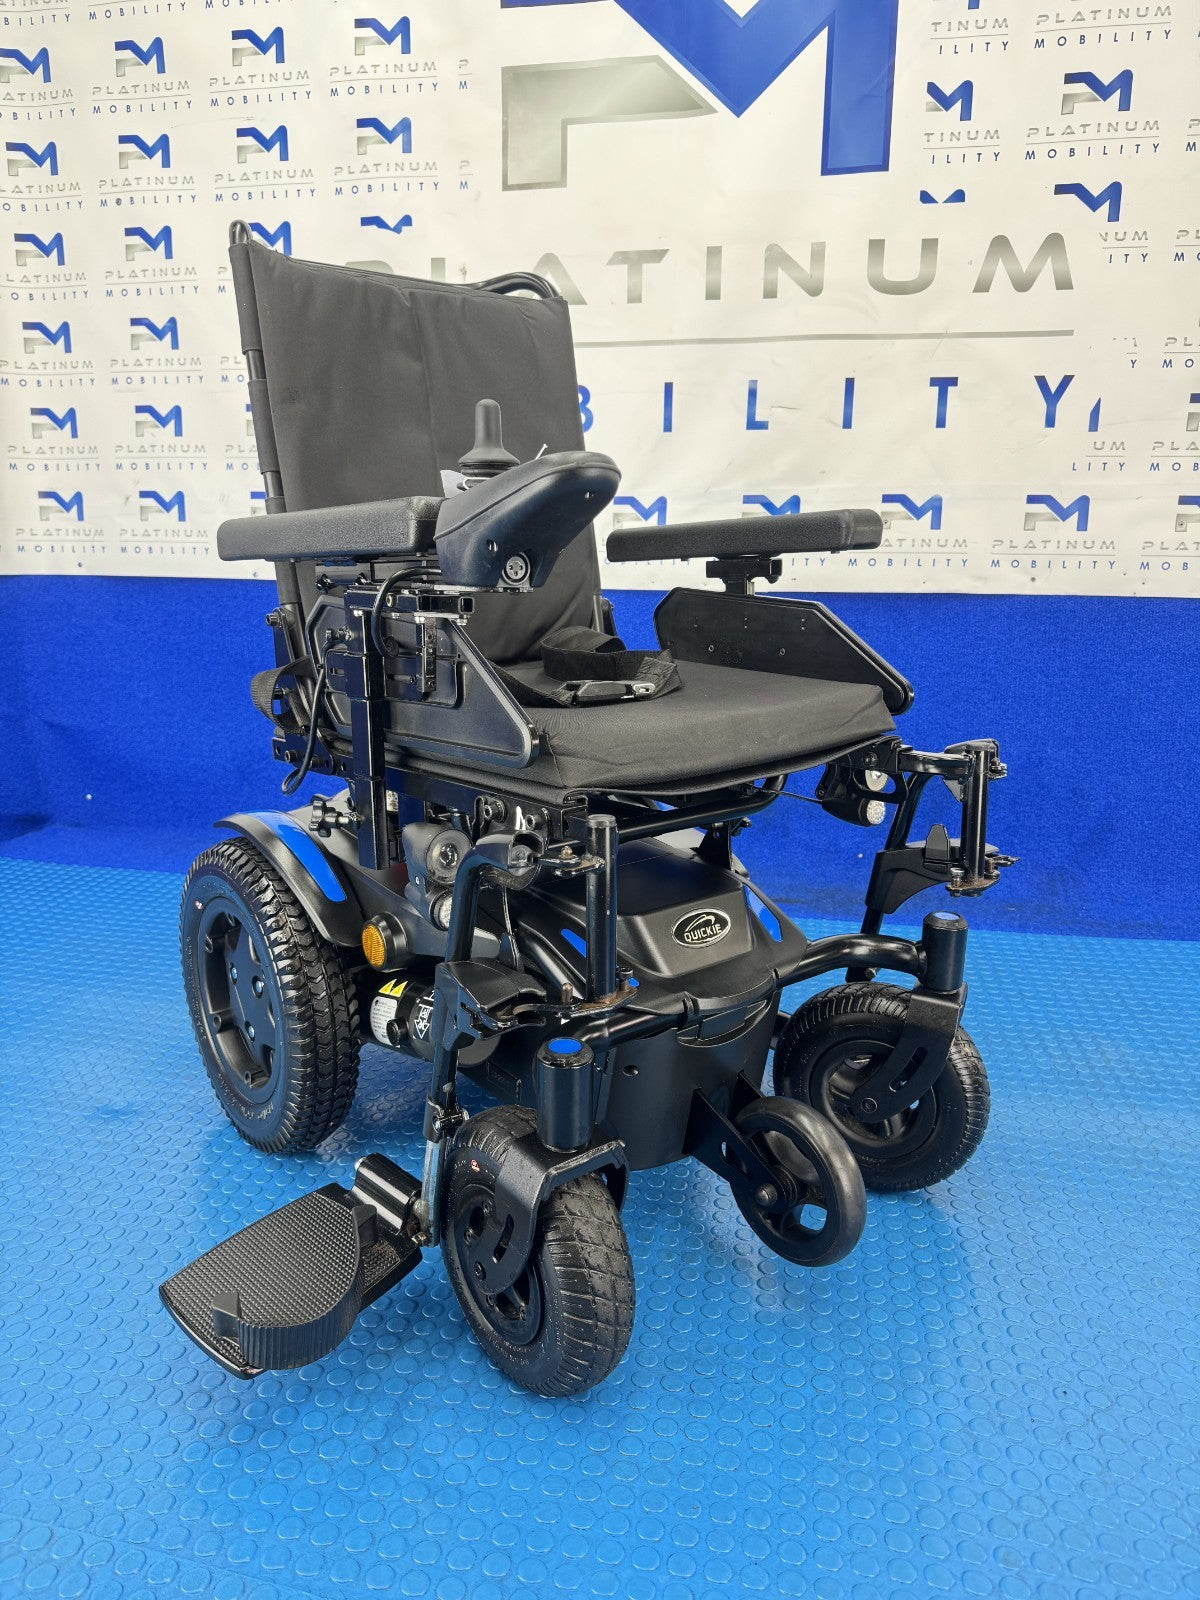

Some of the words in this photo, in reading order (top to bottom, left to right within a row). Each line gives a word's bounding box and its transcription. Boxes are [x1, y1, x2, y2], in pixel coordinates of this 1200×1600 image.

[89, 2, 185, 20] MOBILITY
[1036, 5, 1171, 25] PLATINUM
[1034, 29, 1171, 49] MOBILITY
[330, 61, 437, 76] PLATINUM
[209, 70, 309, 87] PLATINUM
[92, 80, 190, 95] PLATINUM
[330, 82, 438, 97] MOBILITY
[210, 90, 312, 107] MOBILITY
[93, 100, 192, 114] MOBILITY
[1026, 120, 1159, 138] PLATINUM
[1025, 143, 1160, 160] MOBILITY
[334, 161, 437, 176] PLATINUM
[99, 176, 195, 188] PLATINUM
[214, 168, 314, 183] PLATINUM
[215, 188, 316, 202] MOBILITY
[335, 182, 440, 196] MOBILITY
[105, 266, 197, 280] PLATINUM
[106, 286, 199, 298] MOBILITY
[0, 360, 93, 370] PLATINUM
[110, 357, 202, 367] PLATINUM
[1, 378, 95, 387] MOBILITY
[112, 375, 203, 385] MOBILITY
[8, 445, 98, 454] PLATINUM
[115, 444, 206, 453] PLATINUM
[9, 463, 101, 472] MOBILITY
[116, 462, 208, 471] MOBILITY
[16, 528, 104, 537] PLATINUM
[120, 528, 208, 538] PLATINUM
[18, 545, 105, 553] MOBILITY
[121, 546, 209, 555] MOBILITY
[992, 539, 1116, 550] PLATINUM
[848, 558, 968, 567] MOBILITY
[991, 559, 1116, 569] MOBILITY
[684, 923, 722, 943] QUICKIE
